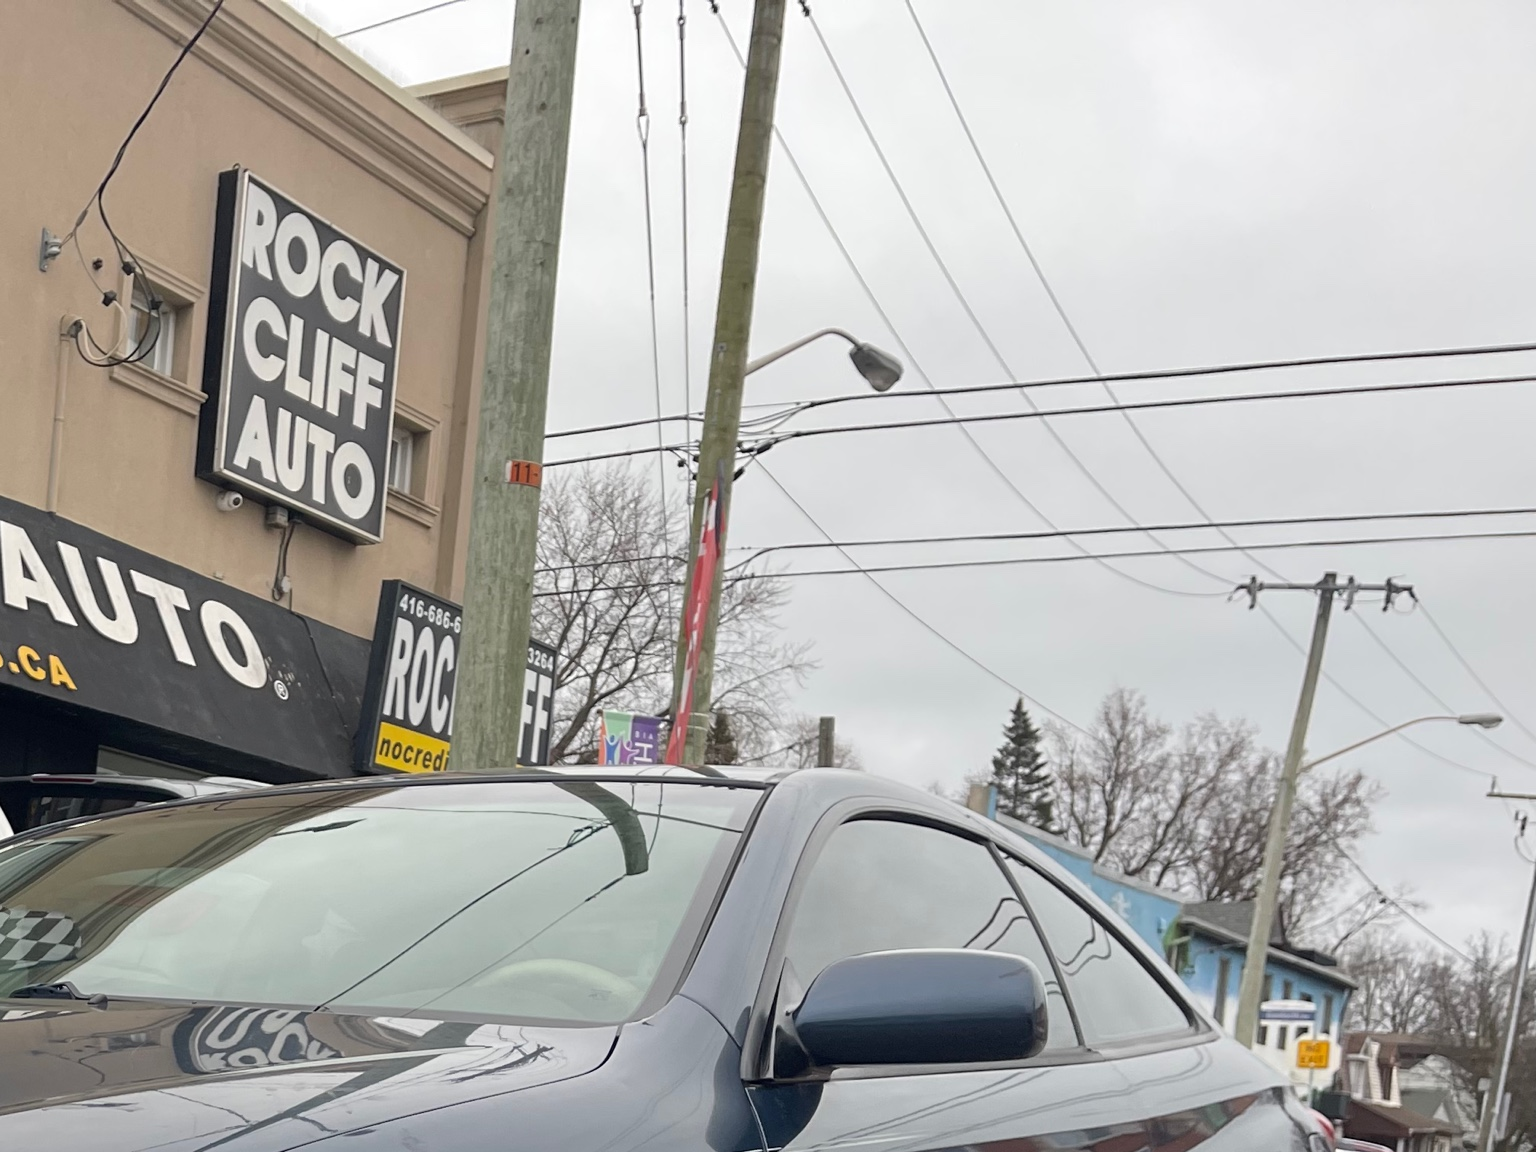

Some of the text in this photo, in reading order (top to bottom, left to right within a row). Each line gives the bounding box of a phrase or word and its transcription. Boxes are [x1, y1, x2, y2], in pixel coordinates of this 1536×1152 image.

[242, 181, 400, 348] ROCK
[243, 296, 386, 430] CLIFF
[233, 394, 376, 520] AUTO
[399, 593, 462, 634] 416-686-6
[379, 737, 451, 771] nocredi
